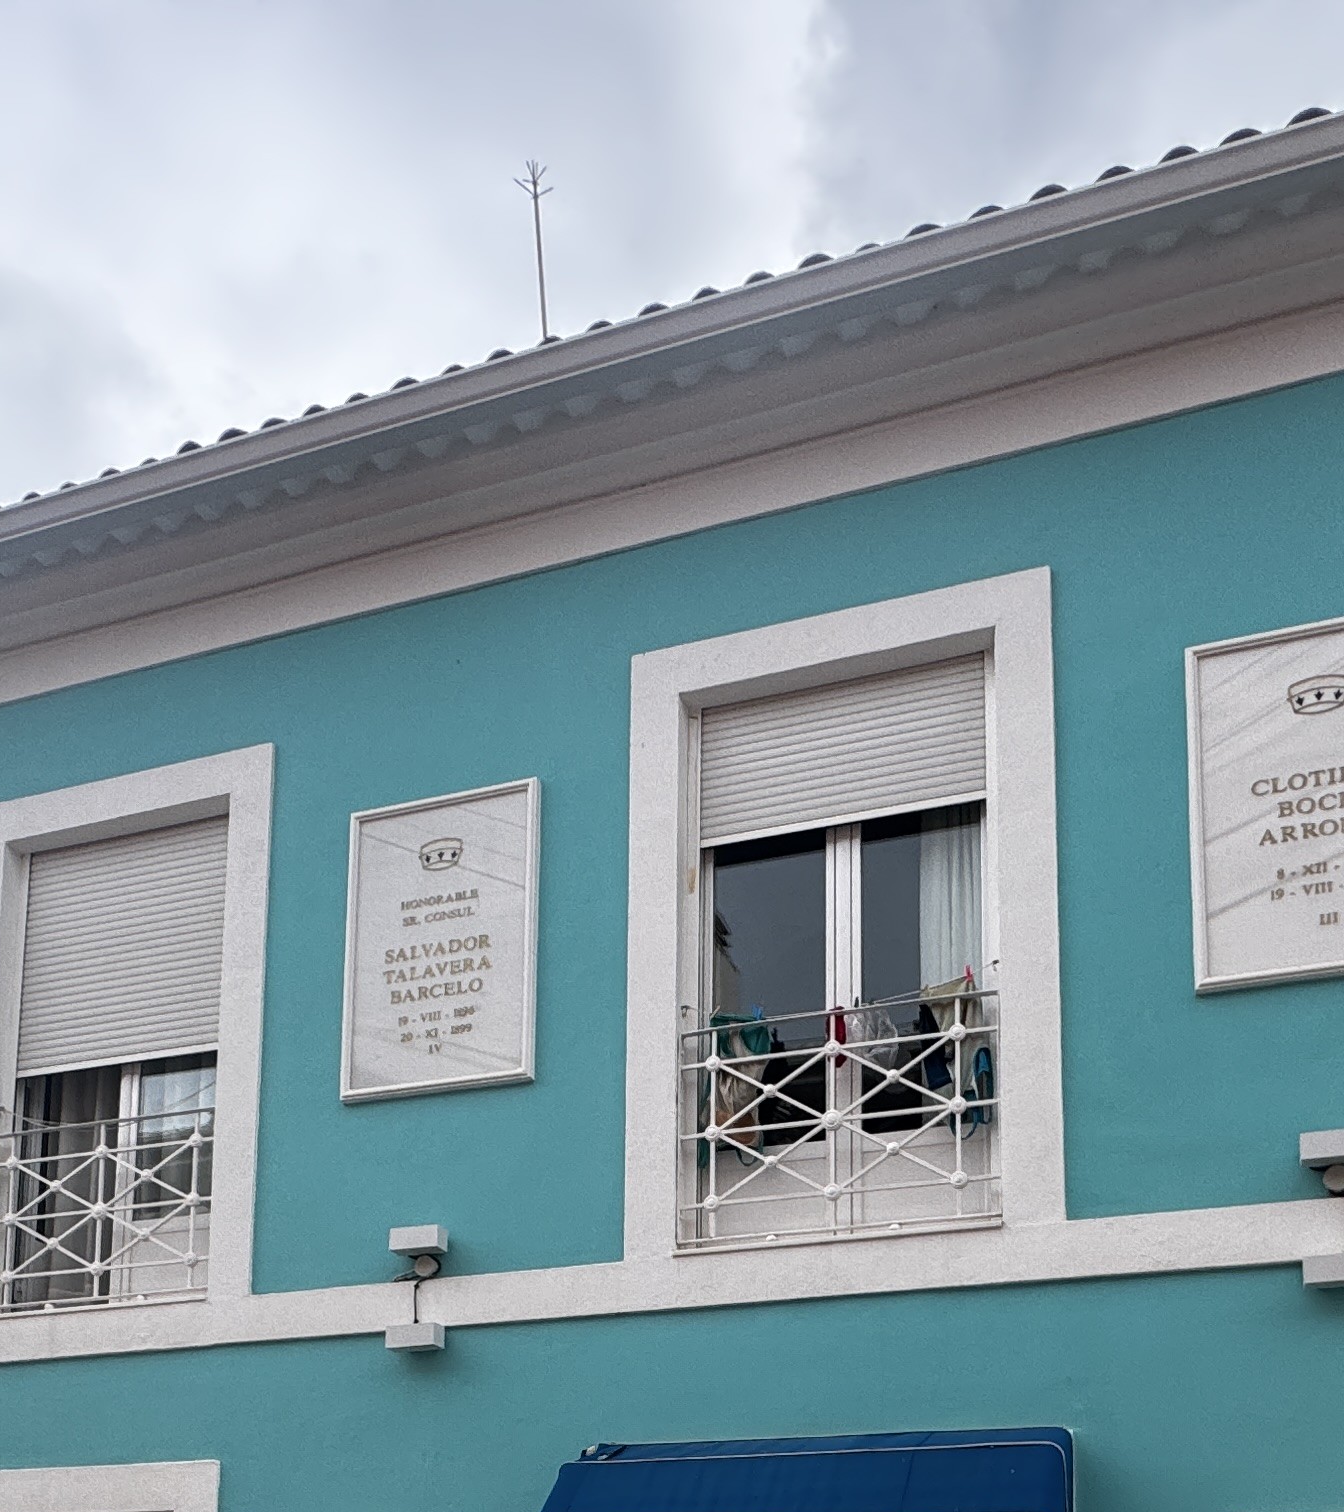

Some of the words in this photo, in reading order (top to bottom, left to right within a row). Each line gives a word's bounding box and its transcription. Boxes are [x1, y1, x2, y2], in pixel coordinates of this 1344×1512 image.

[1302, 861, 1328, 877] XII
[401, 888, 479, 911] HONORABLE
[1271, 888, 1285, 901] 19
[1302, 881, 1333, 895] VIII
[424, 906, 475, 923] CONSUL
[1319, 911, 1339, 925] III
[384, 934, 491, 965] SALVADOR
[383, 955, 492, 985] TALAVERA
[391, 978, 484, 1005] BARCELO
